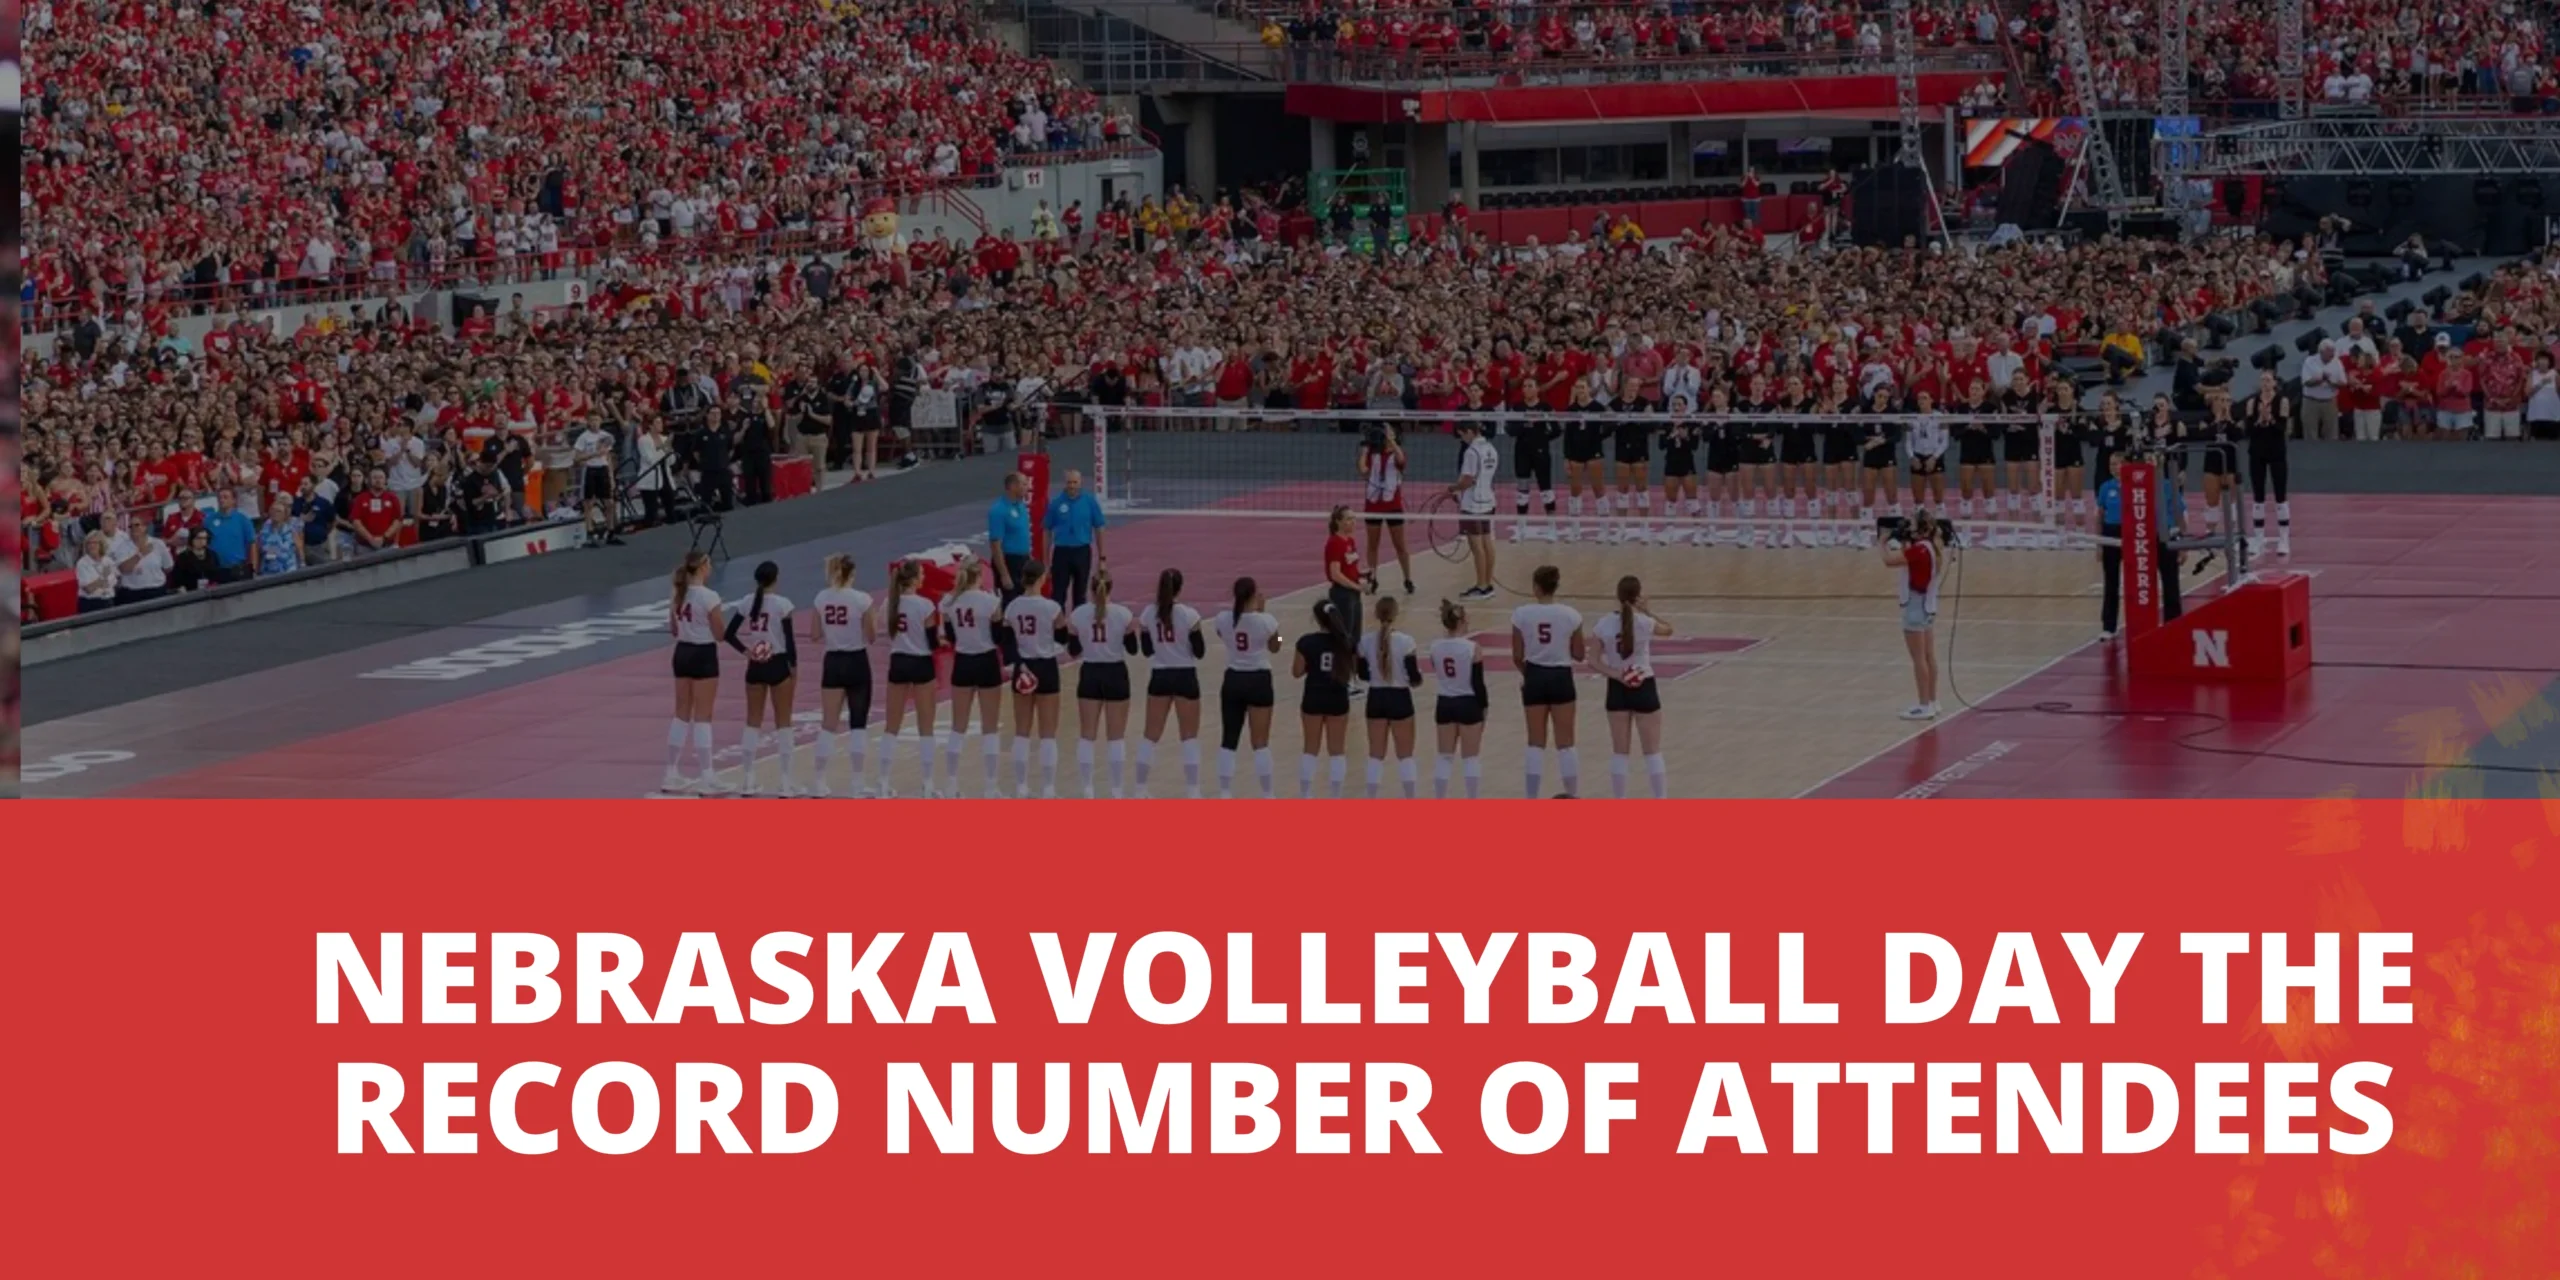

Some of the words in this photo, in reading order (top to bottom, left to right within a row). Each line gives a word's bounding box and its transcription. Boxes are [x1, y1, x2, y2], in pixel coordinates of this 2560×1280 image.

[1027, 171, 1041, 185] 11
[570, 283, 581, 300] 9
[2131, 487, 2150, 606] HUSKERS
[824, 605, 849, 625] 22
[955, 608, 975, 628] 14
[1016, 615, 1037, 636] 13
[1091, 623, 1107, 643] 11
[1538, 623, 1552, 644] 5
[1235, 632, 1249, 651] 9
[2191, 628, 2231, 668] N
[1320, 652, 1333, 672] 8
[1443, 657, 1456, 679] 6
